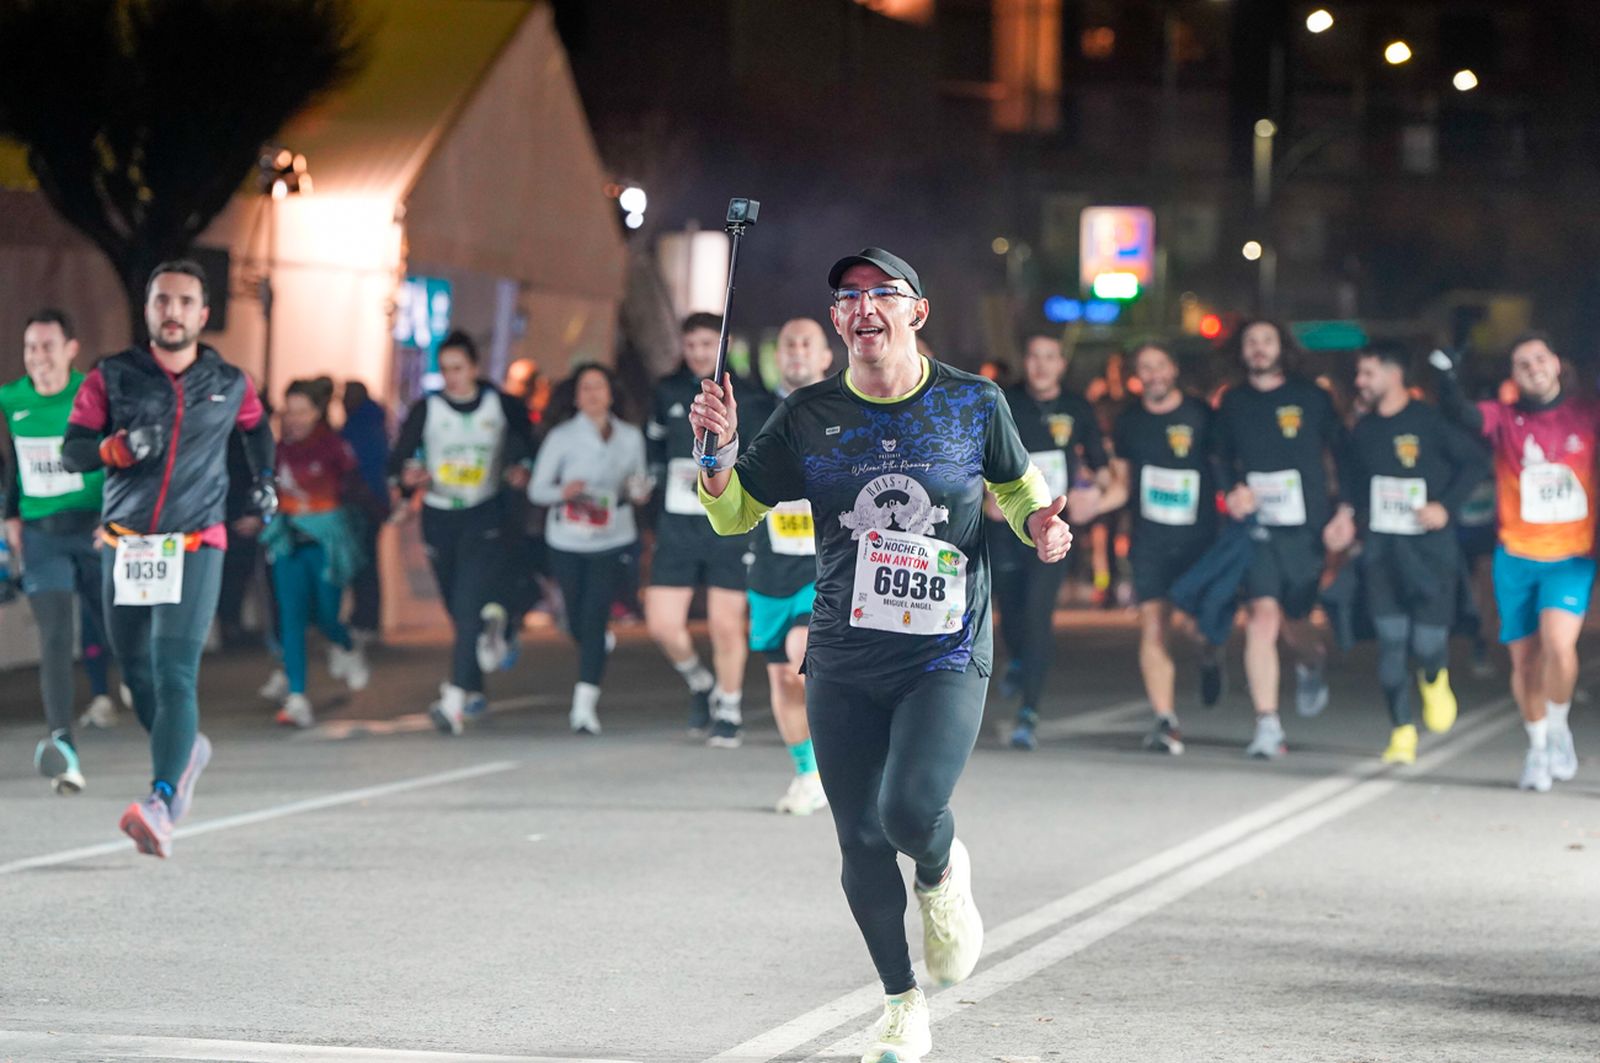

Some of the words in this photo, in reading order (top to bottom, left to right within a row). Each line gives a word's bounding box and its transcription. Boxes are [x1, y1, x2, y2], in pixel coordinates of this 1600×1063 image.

[883, 541, 918, 554] NOCHE
[870, 551, 892, 565] SAN
[892, 554, 929, 570] ANTÓN
[125, 561, 167, 579] 1039
[874, 565, 946, 602] 6938
[883, 598, 909, 608] MIGUEL
[910, 601, 932, 610] ANGEL
